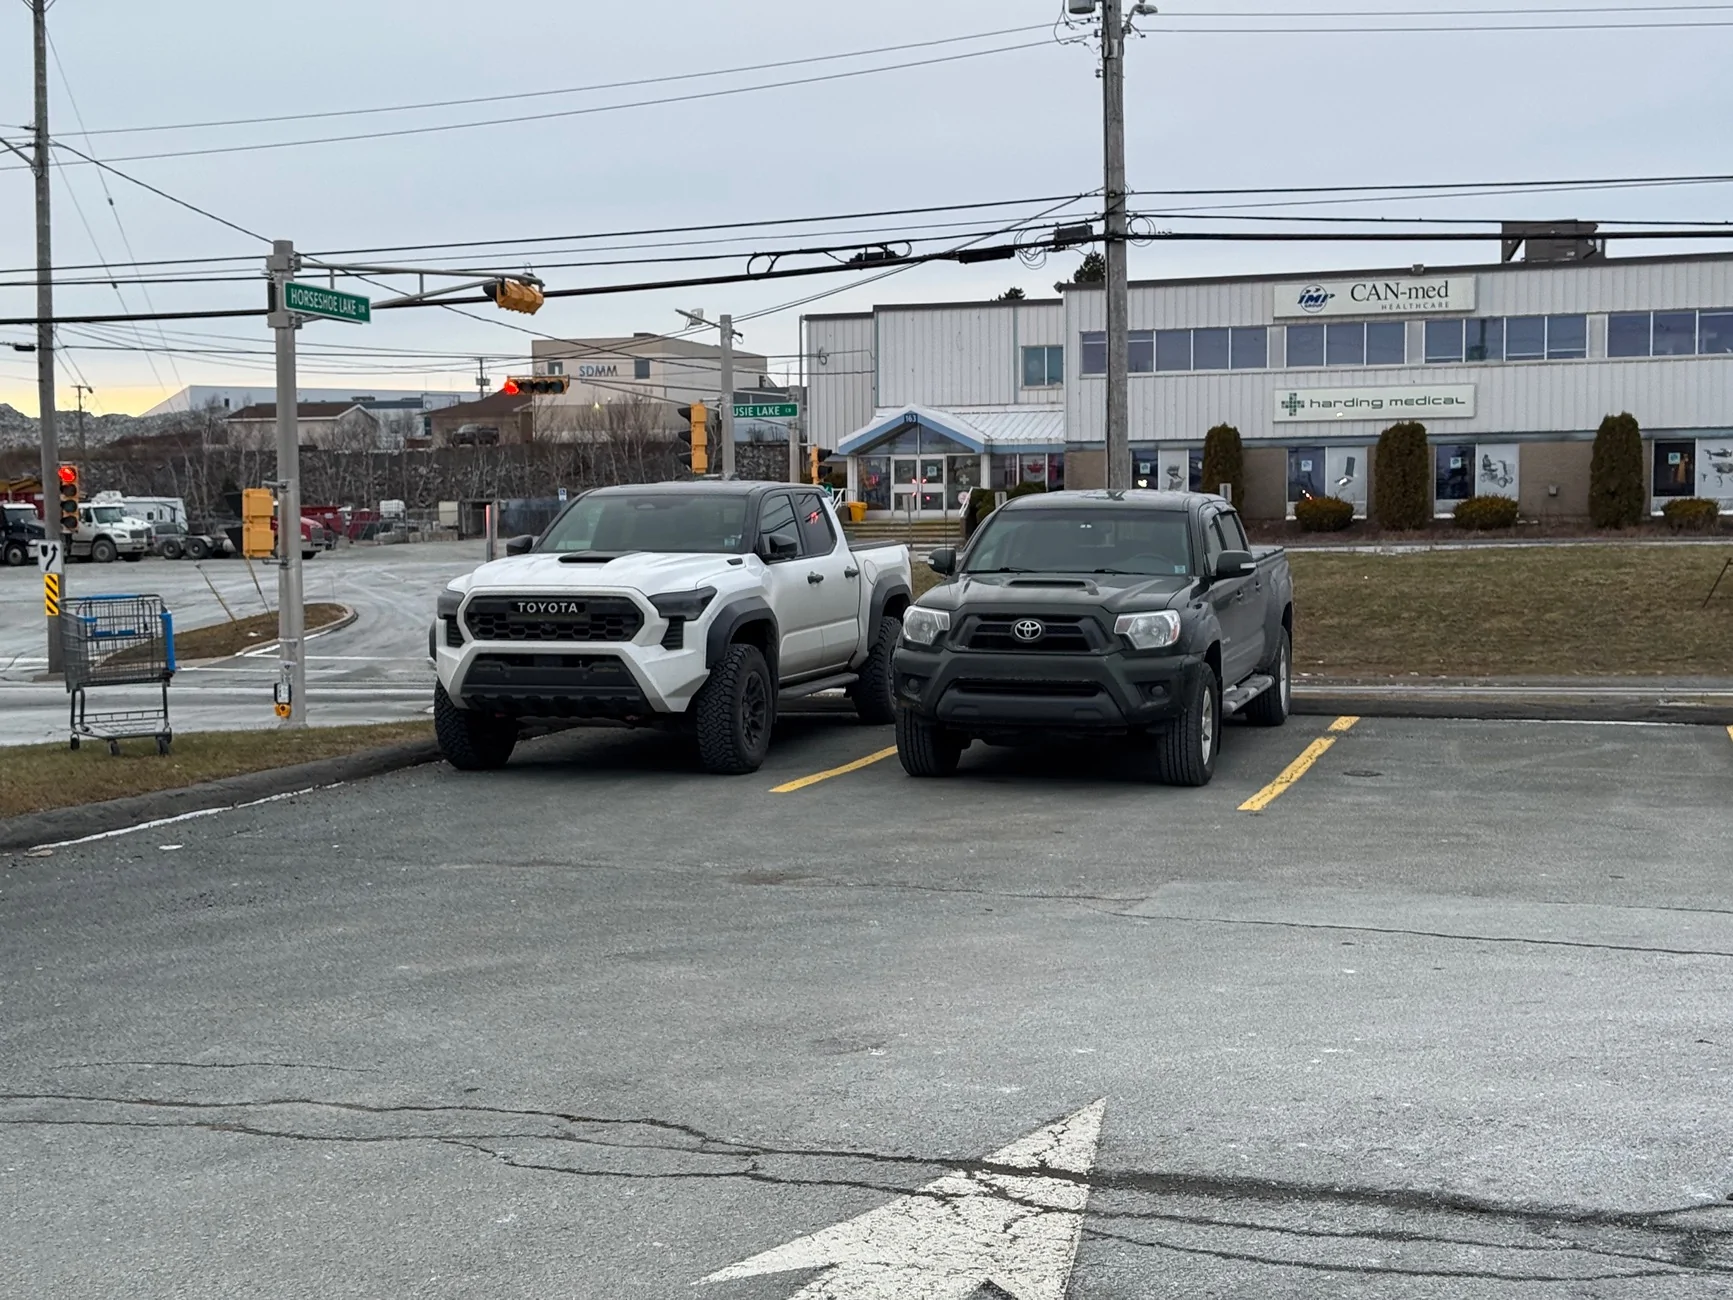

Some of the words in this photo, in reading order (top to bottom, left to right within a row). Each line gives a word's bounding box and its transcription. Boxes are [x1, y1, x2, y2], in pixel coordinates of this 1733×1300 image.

[1350, 280, 1449, 302] CAN-med
[290, 288, 338, 312] HORSESHOE
[339, 297, 357, 315] LAKE
[1381, 301, 1450, 311] HEALTHCARE
[579, 365, 619, 377] SDMM
[1309, 397, 1384, 410] harding
[1389, 395, 1467, 408] medical
[733, 406, 754, 417] USIE
[756, 406, 781, 416] LAKE
[517, 602, 578, 613] TOYOTA
